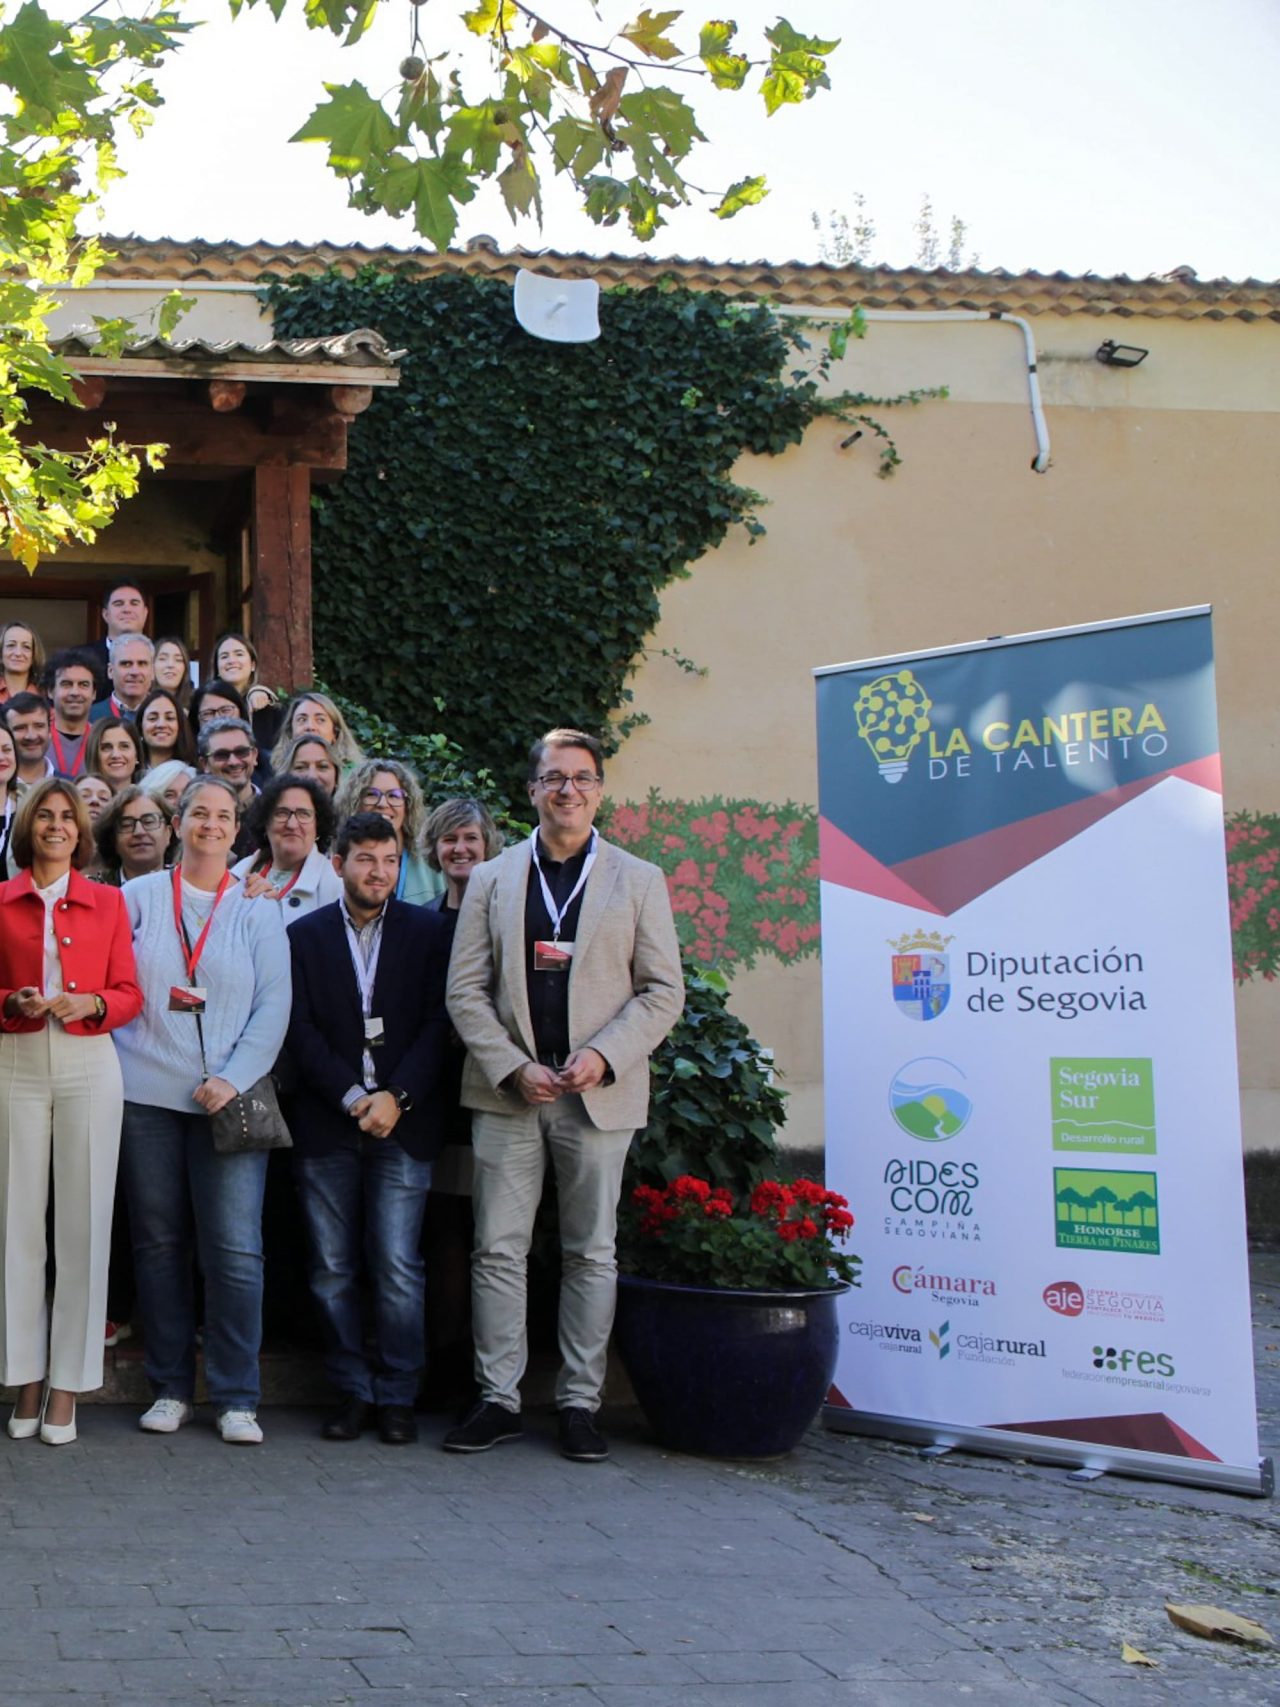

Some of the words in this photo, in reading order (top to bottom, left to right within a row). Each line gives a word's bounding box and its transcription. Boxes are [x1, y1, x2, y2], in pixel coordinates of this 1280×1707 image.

[928, 728, 971, 759] LA
[982, 703, 1167, 752] CANTERA
[928, 756, 971, 780] DE
[992, 733, 1168, 774] TALENTO
[967, 946, 1144, 982] Diputación
[967, 987, 1005, 1012] de
[1017, 986, 1147, 1019] Segovia
[1059, 1066, 1141, 1091] Segovia
[1059, 1088, 1099, 1109] Sur
[1061, 1132, 1117, 1146] Desarrollo
[1119, 1135, 1145, 1146] rural
[884, 1159, 979, 1188] AIDES
[890, 1186, 973, 1216] COM
[884, 1217, 980, 1231] CAMPIÑA
[884, 1226, 981, 1241] SEGOVIANA
[1074, 1224, 1141, 1238] HONORSE
[1058, 1232, 1096, 1246] TIERRA
[1098, 1238, 1111, 1247] DE
[1112, 1237, 1158, 1250] PINARES
[892, 1265, 997, 1296] Cámara
[931, 1291, 979, 1307] Segovia
[1046, 1287, 1082, 1310] aje
[1086, 1294, 1164, 1312] SEGOVIA
[848, 1320, 922, 1342] cajaviva
[879, 1341, 922, 1354] cajarural
[957, 1332, 1047, 1358] cajarural
[958, 1351, 1016, 1367] Fundación
[1119, 1349, 1175, 1377] fes
